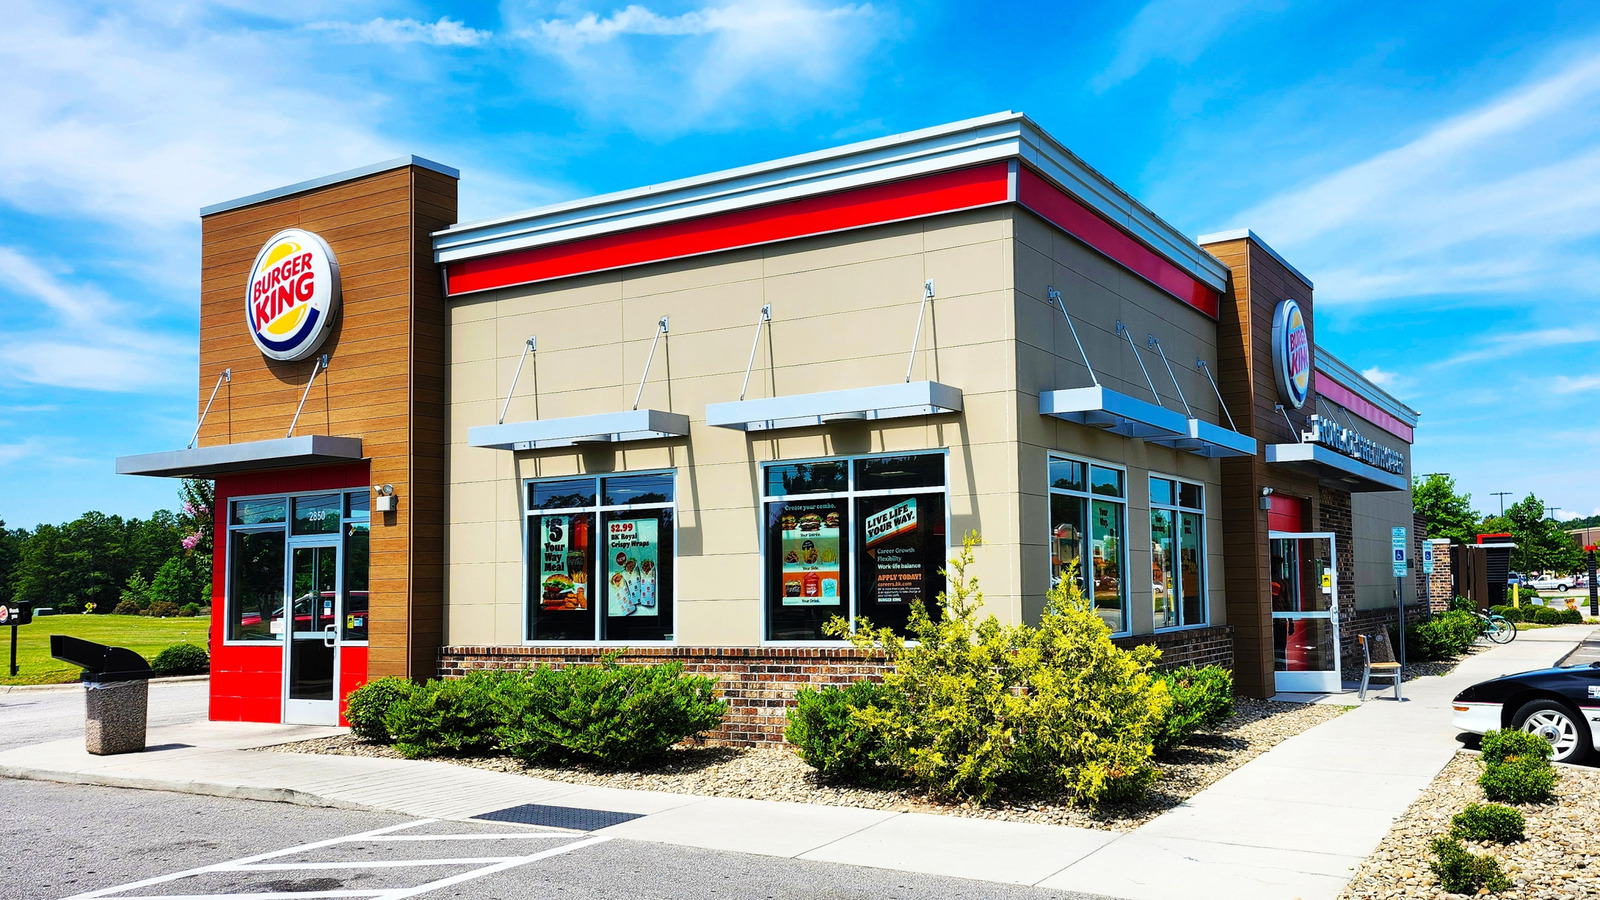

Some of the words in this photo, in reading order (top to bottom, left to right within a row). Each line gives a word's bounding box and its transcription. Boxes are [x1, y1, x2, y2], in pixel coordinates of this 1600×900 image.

[254, 252, 313, 304] BURGER
[256, 271, 315, 334] KING
[309, 510, 326, 521] 2850
[867, 512, 888, 529] LIVE
[889, 504, 909, 519] LIFE
[611, 522, 633, 533] $2.99
[868, 520, 893, 538] YOUR
[893, 510, 915, 526] WAY.
[546, 518, 563, 542] $5
[620, 532, 638, 541] Royal
[544, 542, 565, 552] Your
[611, 541, 631, 549] Crispy
[631, 540, 650, 548] Wraps
[544, 552, 563, 563] Way
[544, 562, 565, 572] Meal
